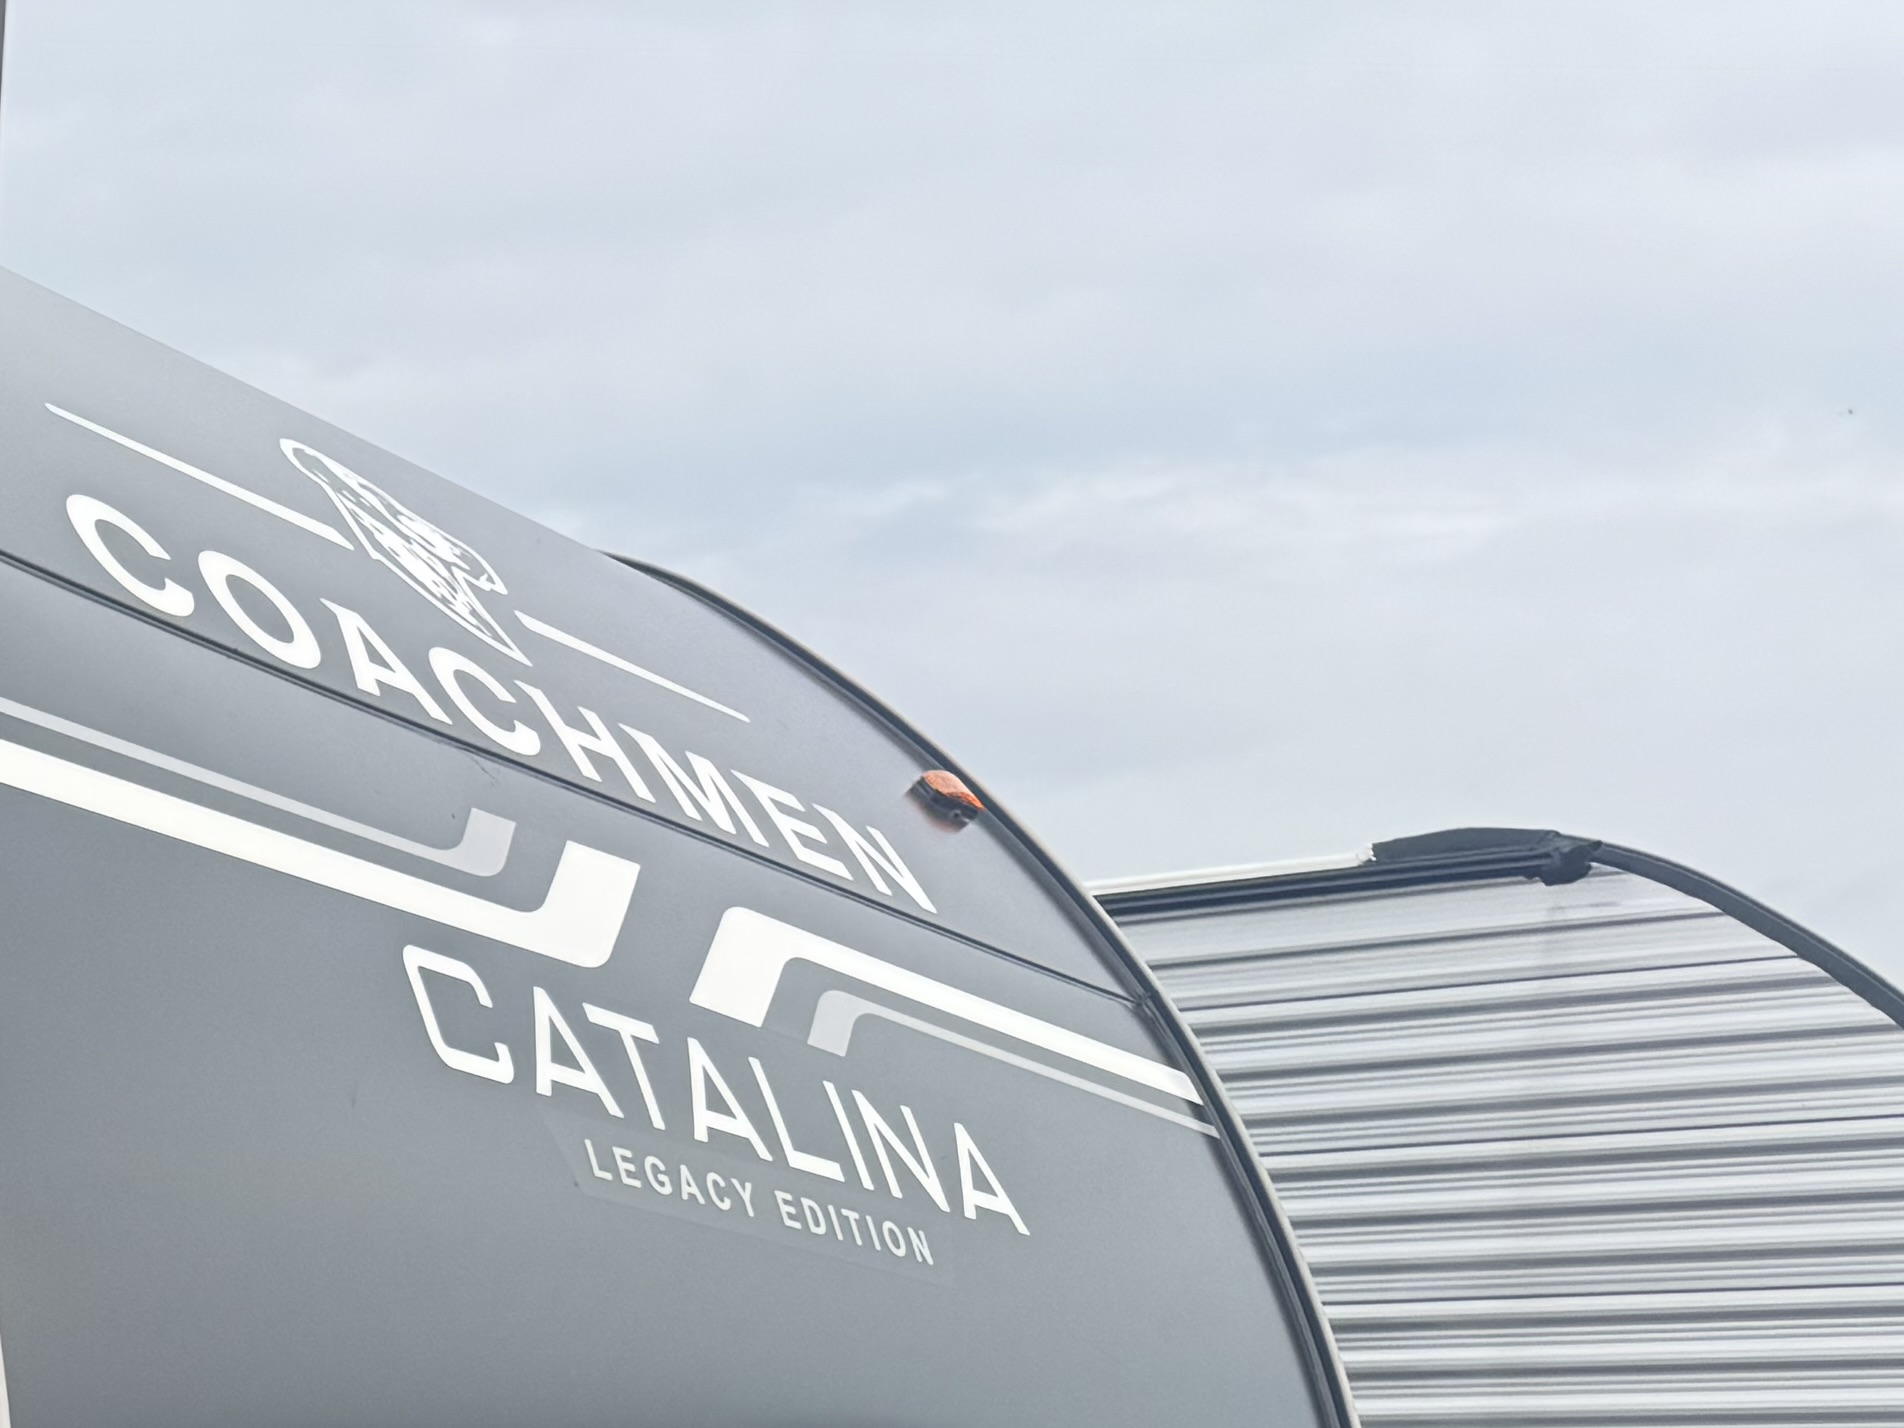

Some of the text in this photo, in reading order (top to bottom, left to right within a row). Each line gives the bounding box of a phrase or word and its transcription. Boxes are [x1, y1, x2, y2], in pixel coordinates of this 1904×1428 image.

[65, 493, 937, 914] COACHMEN
[402, 944, 1030, 1236] CATALINA
[583, 1137, 935, 1266] LEGACY EDITION
